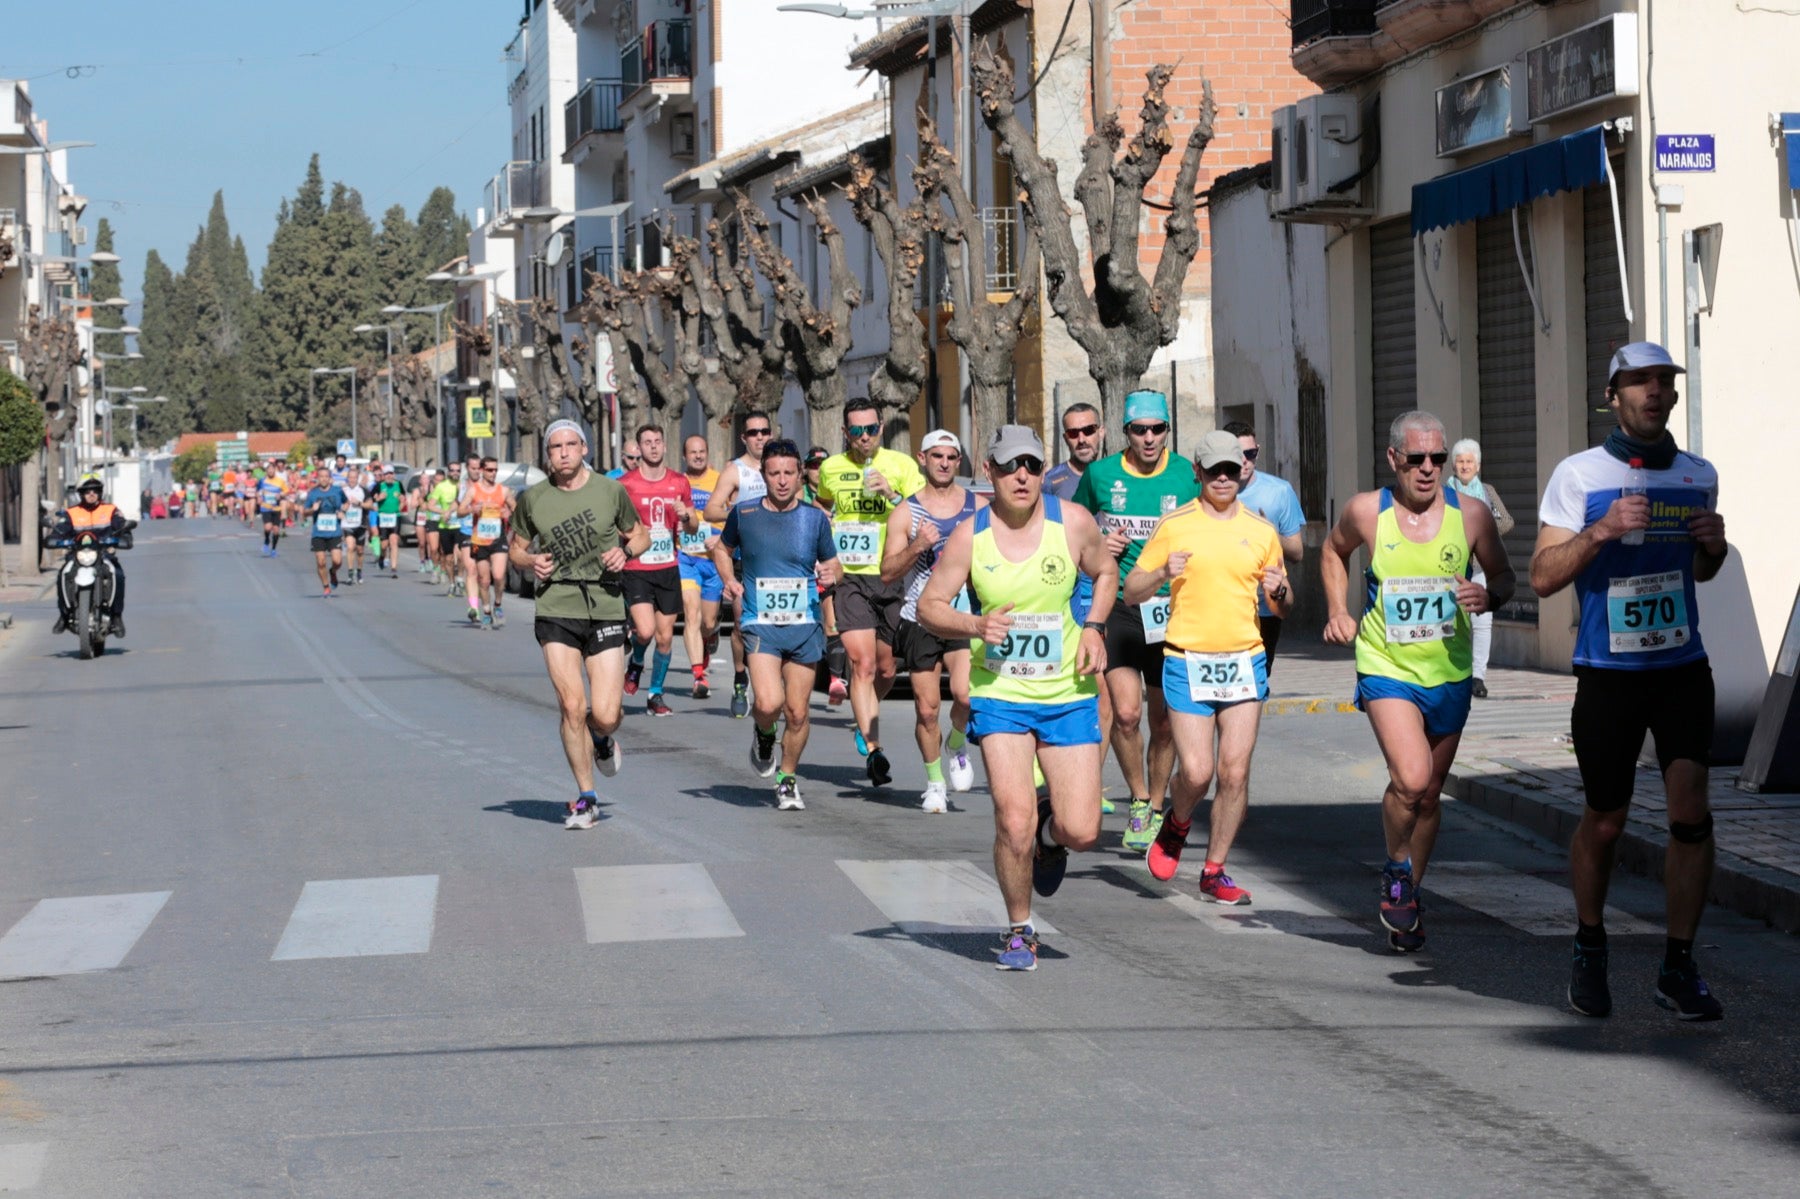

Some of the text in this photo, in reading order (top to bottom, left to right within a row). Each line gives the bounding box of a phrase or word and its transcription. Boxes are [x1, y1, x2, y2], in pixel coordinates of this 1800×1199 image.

[1668, 137, 1699, 148] PLAZA
[1659, 153, 1712, 168] NARANJOS
[551, 508, 596, 540] BENE
[1108, 517, 1135, 528] CAJA
[839, 535, 870, 551] 673
[766, 593, 799, 610] 357
[1396, 596, 1443, 622] 971
[1624, 596, 1675, 628] 570
[999, 633, 1050, 658] 970
[1199, 662, 1243, 684] 252
